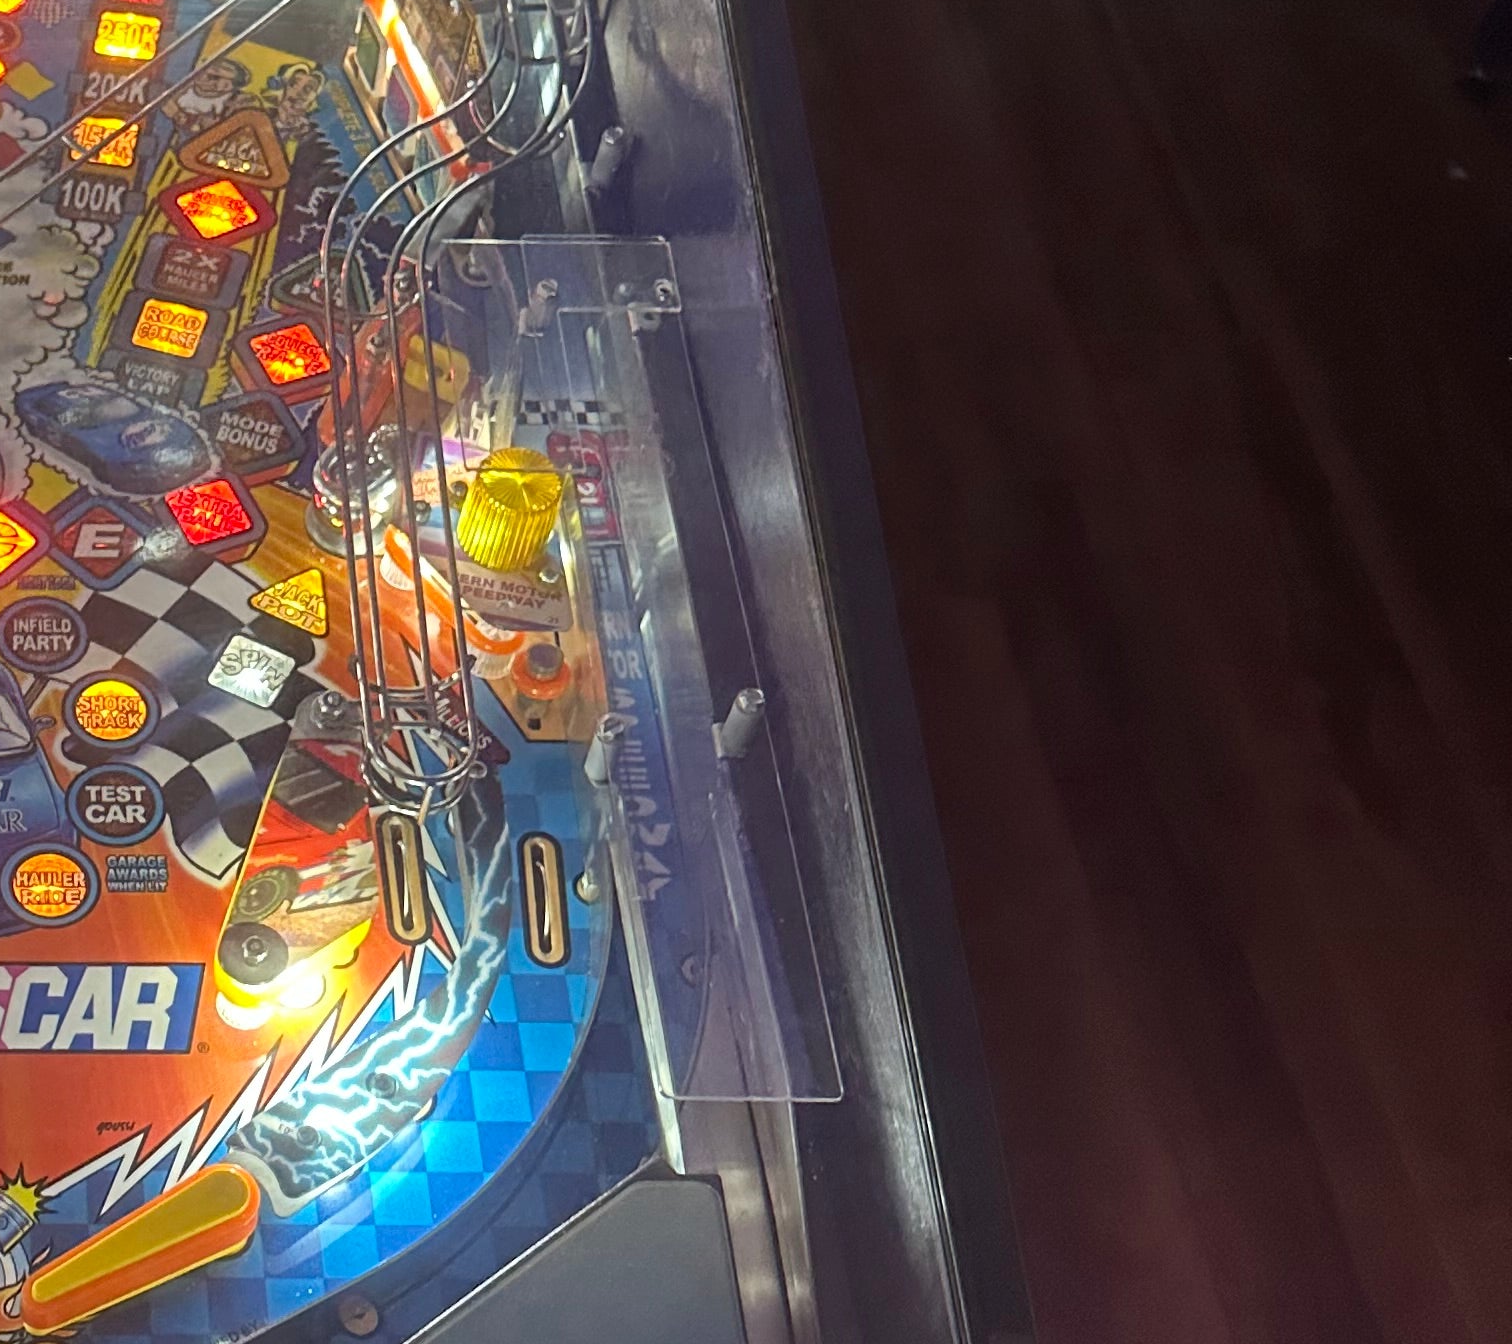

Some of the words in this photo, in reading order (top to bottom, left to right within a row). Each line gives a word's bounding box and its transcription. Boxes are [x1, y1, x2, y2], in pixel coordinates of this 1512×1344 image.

[100, 19, 159, 52] 250K
[61, 181, 127, 214] 100K
[145, 306, 201, 332] ROAD
[125, 362, 180, 385] VICTORY
[127, 378, 171, 396] LAP
[220, 411, 285, 438] MODE
[216, 425, 279, 455] BONUS
[73, 523, 124, 558] E
[273, 582, 324, 610] JACK
[257, 595, 326, 631] POT
[13, 619, 72, 634] INFIELD
[12, 634, 75, 652] PARTY
[218, 648, 287, 692] SPIN
[78, 695, 141, 713] SHORT
[80, 712, 143, 729] TRACK
[85, 785, 147, 803] TEST
[85, 805, 147, 824] CAR
[106, 855, 167, 868] GARAGE
[15, 872, 86, 887] HAULER
[106, 868, 169, 881] AWARDS
[20, 889, 83, 905] RIDE
